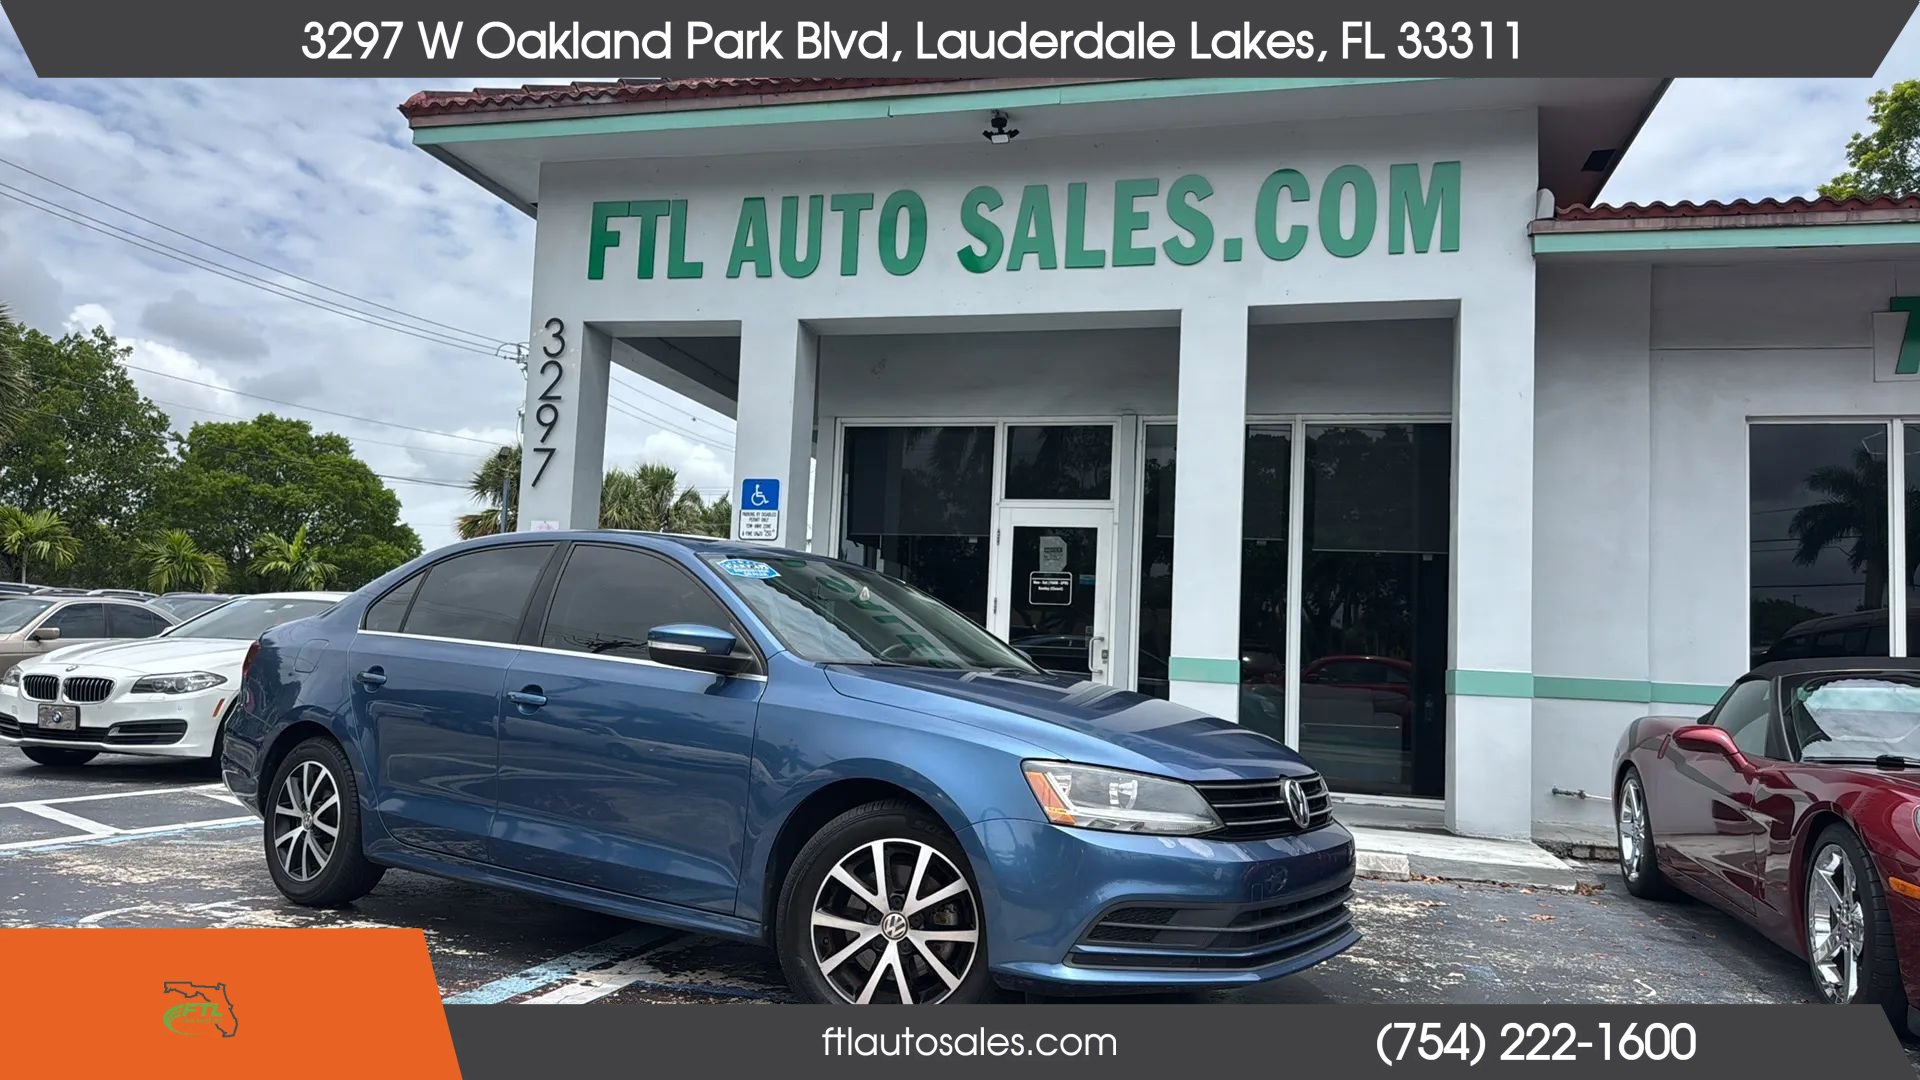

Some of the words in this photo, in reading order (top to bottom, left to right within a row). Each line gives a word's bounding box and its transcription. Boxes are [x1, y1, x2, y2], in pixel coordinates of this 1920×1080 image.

[587, 199, 704, 281] FTL
[726, 190, 928, 279] AUTO
[957, 161, 1461, 274] SALES.COM
[531, 317, 566, 488] 3297
